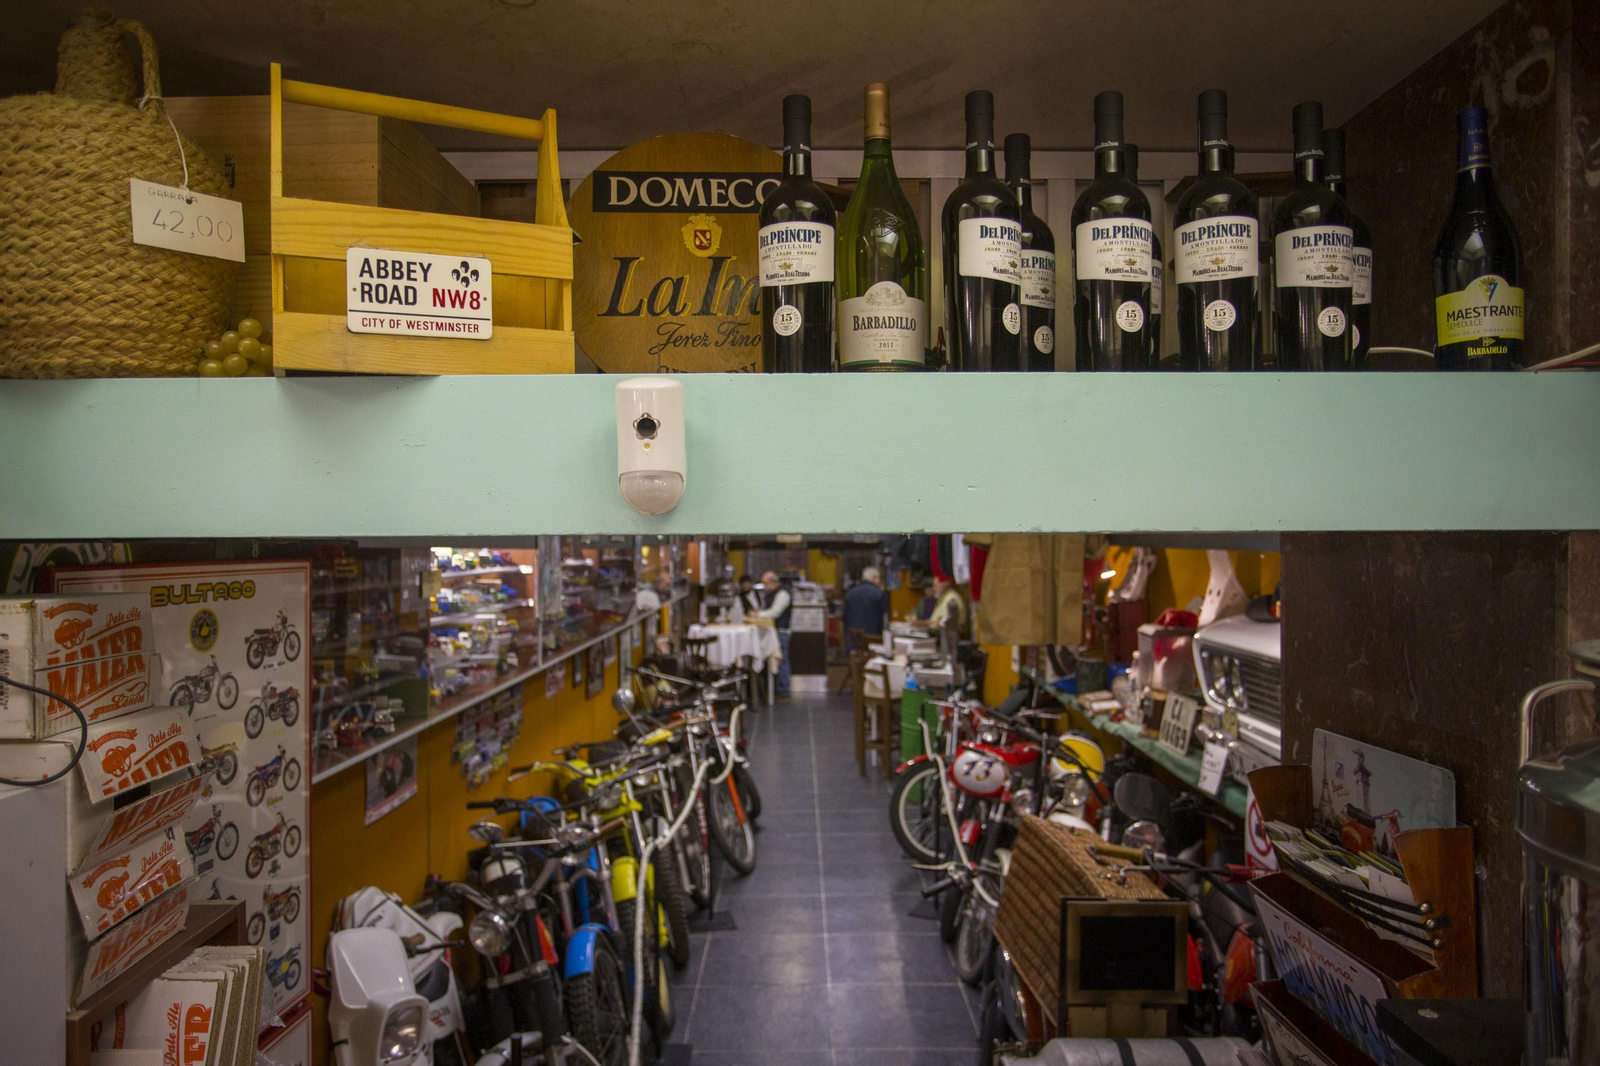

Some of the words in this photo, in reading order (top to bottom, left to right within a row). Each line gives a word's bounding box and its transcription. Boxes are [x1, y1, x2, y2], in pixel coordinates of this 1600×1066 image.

[148, 187, 198, 203] GARRAA
[152, 209, 233, 242] 42,00
[980, 225, 999, 239] DEL
[1181, 231, 1197, 246] DEL
[1198, 221, 1251, 240] PRÍNCIPE
[770, 227, 822, 244] PRÍNCIPE
[1092, 227, 1111, 241] DEL
[1292, 235, 1313, 250] DEL
[1313, 230, 1353, 250] PRÍNCIP
[1190, 238, 1244, 249] AMONTILLADO
[359, 258, 432, 282] ABBEY
[597, 256, 691, 317] La
[360, 282, 417, 306] ROAD
[432, 288, 481, 310] NW8
[781, 313, 792, 322] 15
[1010, 311, 1017, 321] 15
[1126, 309, 1136, 318] 15
[1213, 309, 1226, 317] 15
[1327, 315, 1338, 323] 15
[1446, 305, 1522, 323] MAESTRANTE
[362, 317, 385, 328] CITY
[389, 318, 401, 329] OF
[406, 320, 479, 333] WESTMINSTER
[853, 315, 917, 331] BARBADILLO
[648, 322, 711, 355] Jerez
[715, 321, 761, 348] Fino
[1041, 333, 1050, 341] 15
[1467, 346, 1508, 357] BARBADILLO
[150, 579, 256, 607] BULTACO
[126, 607, 142, 619] Ale
[167, 723, 182, 736] Ale
[167, 1002, 180, 1029] Ale
